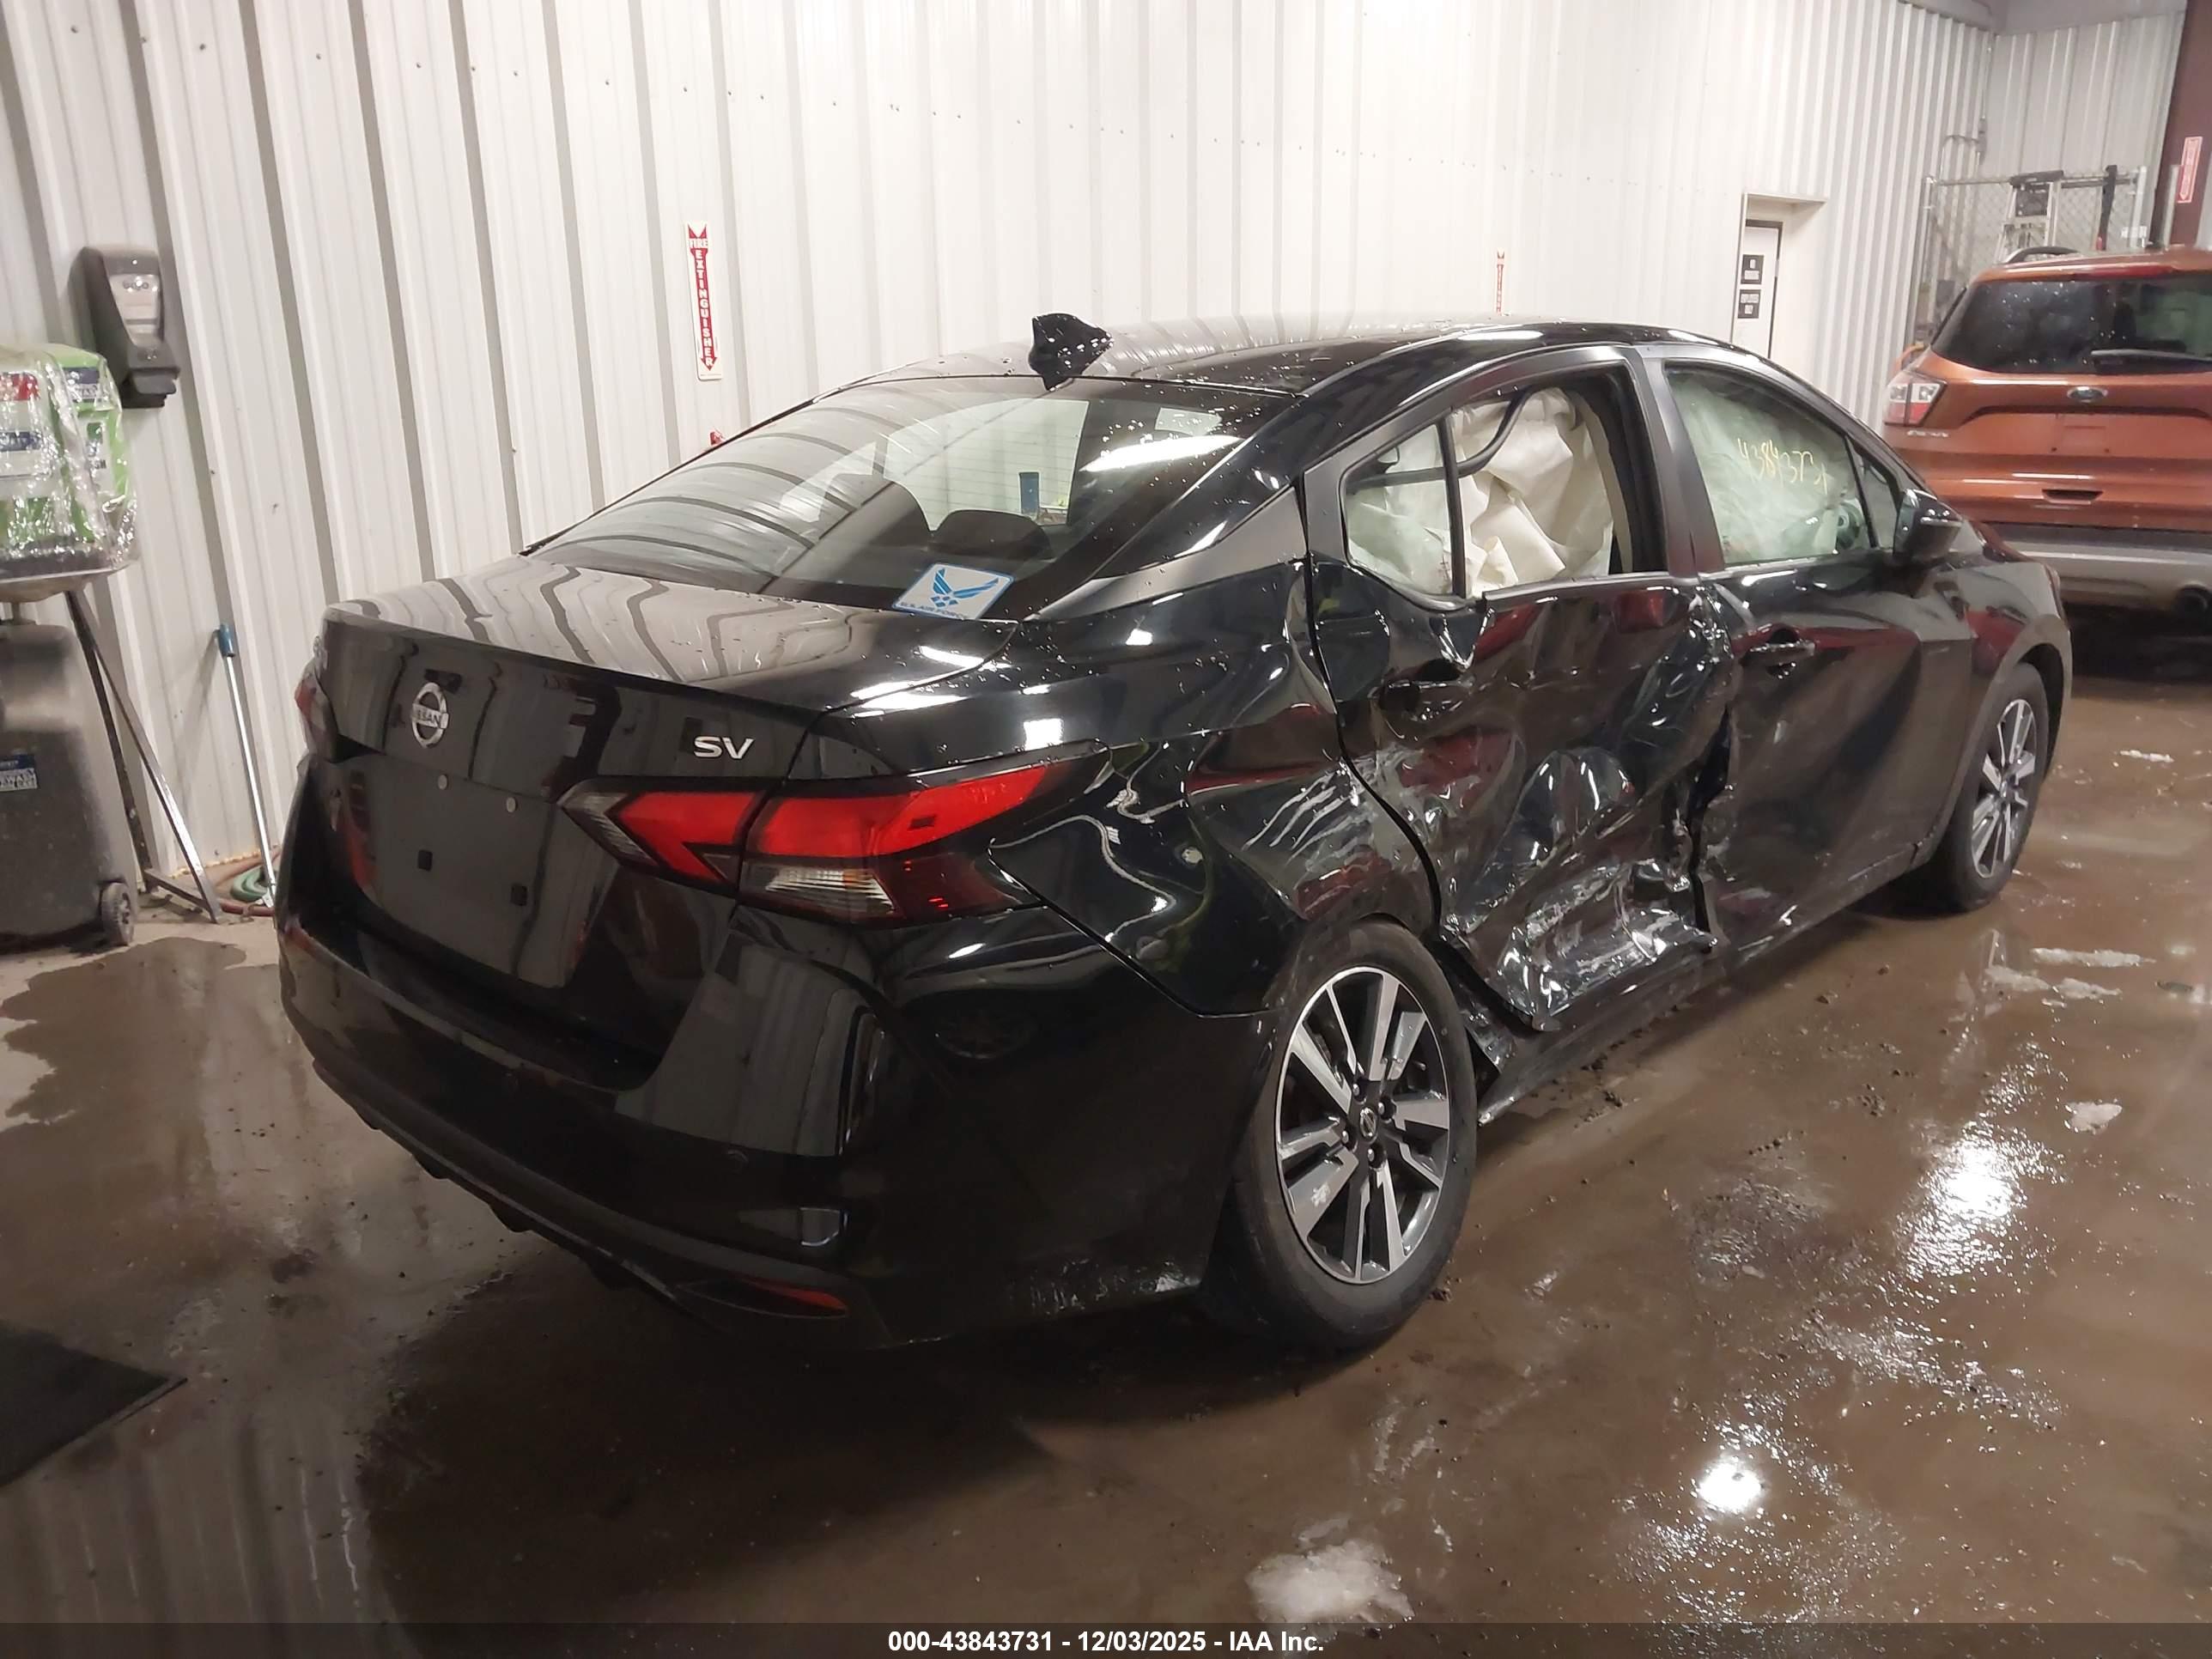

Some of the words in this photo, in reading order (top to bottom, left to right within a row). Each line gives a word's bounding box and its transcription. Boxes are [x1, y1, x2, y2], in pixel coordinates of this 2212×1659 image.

[689, 239, 708, 249] FIRE
[696, 249, 714, 366] EXTINGUISHER
[694, 734, 754, 761] SV
